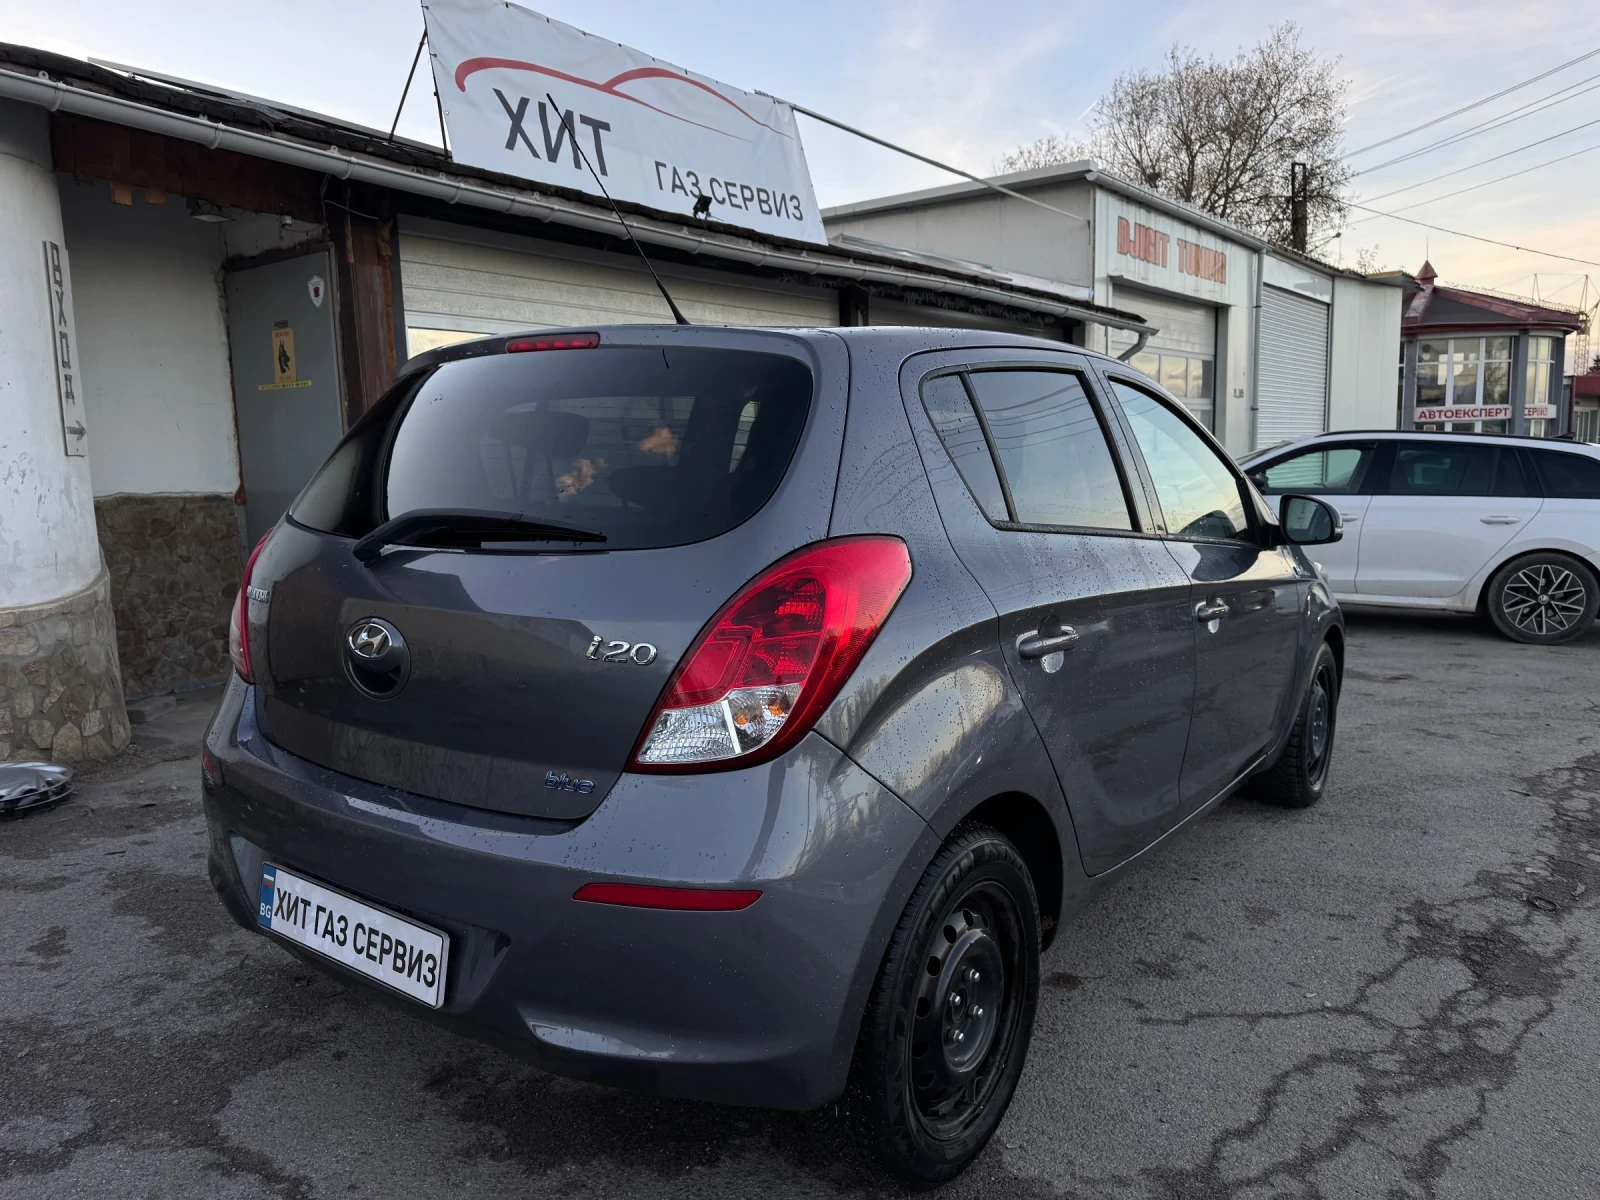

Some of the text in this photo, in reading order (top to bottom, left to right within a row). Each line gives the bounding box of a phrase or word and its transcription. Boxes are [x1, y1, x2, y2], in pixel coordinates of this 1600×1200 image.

[492, 87, 611, 177] ХИТ
[654, 160, 804, 221] ГАЗ СЕРВИЗ
[50, 241, 75, 405] ВХОД
[1418, 407, 1510, 420] АВТОЕКСПЕРТ
[586, 635, 657, 665] i20
[544, 770, 596, 794] blue
[260, 902, 272, 919] BG
[274, 887, 437, 988] ХИТ ГАЗ СЕРВИЗ
